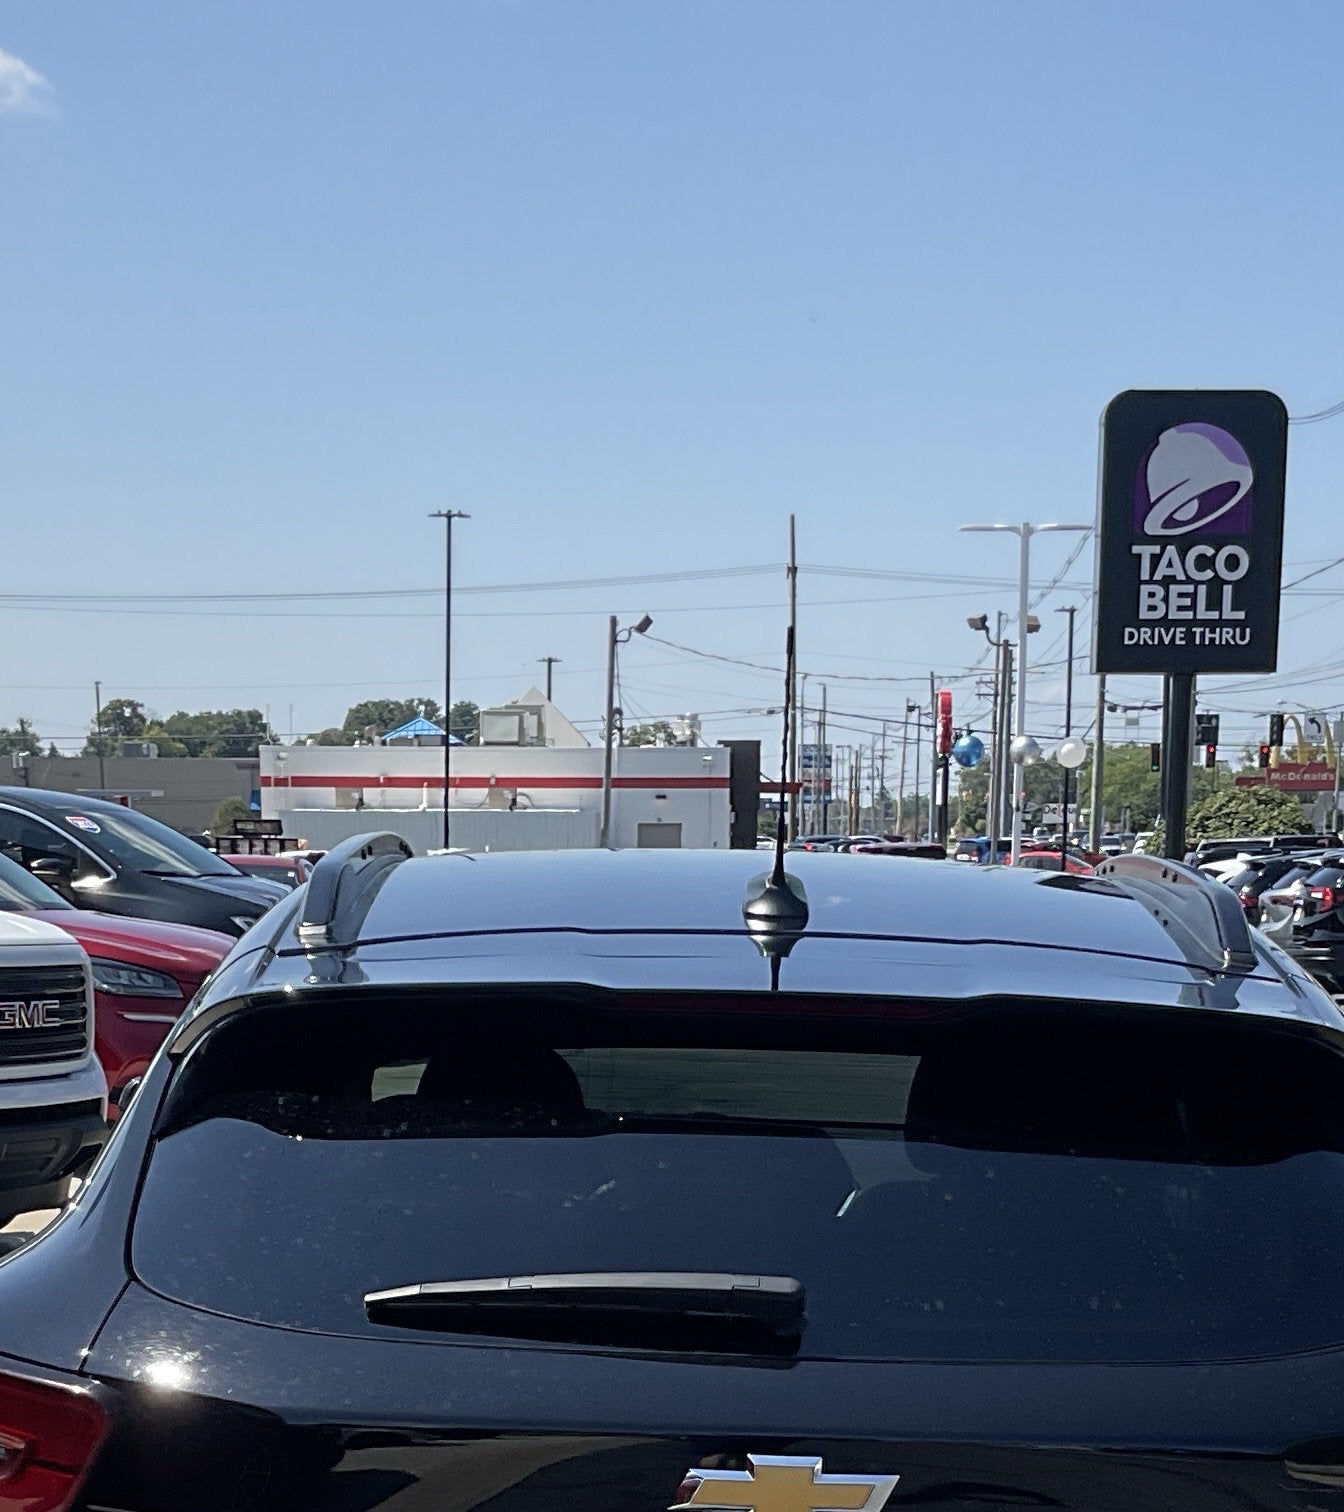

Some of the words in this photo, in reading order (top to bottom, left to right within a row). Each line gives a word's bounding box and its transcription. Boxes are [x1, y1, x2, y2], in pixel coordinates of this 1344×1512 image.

[1131, 544, 1250, 582] TACO
[1138, 583, 1246, 620] BELL
[1123, 626, 1187, 646] DRIVE
[1192, 626, 1251, 646] THRU
